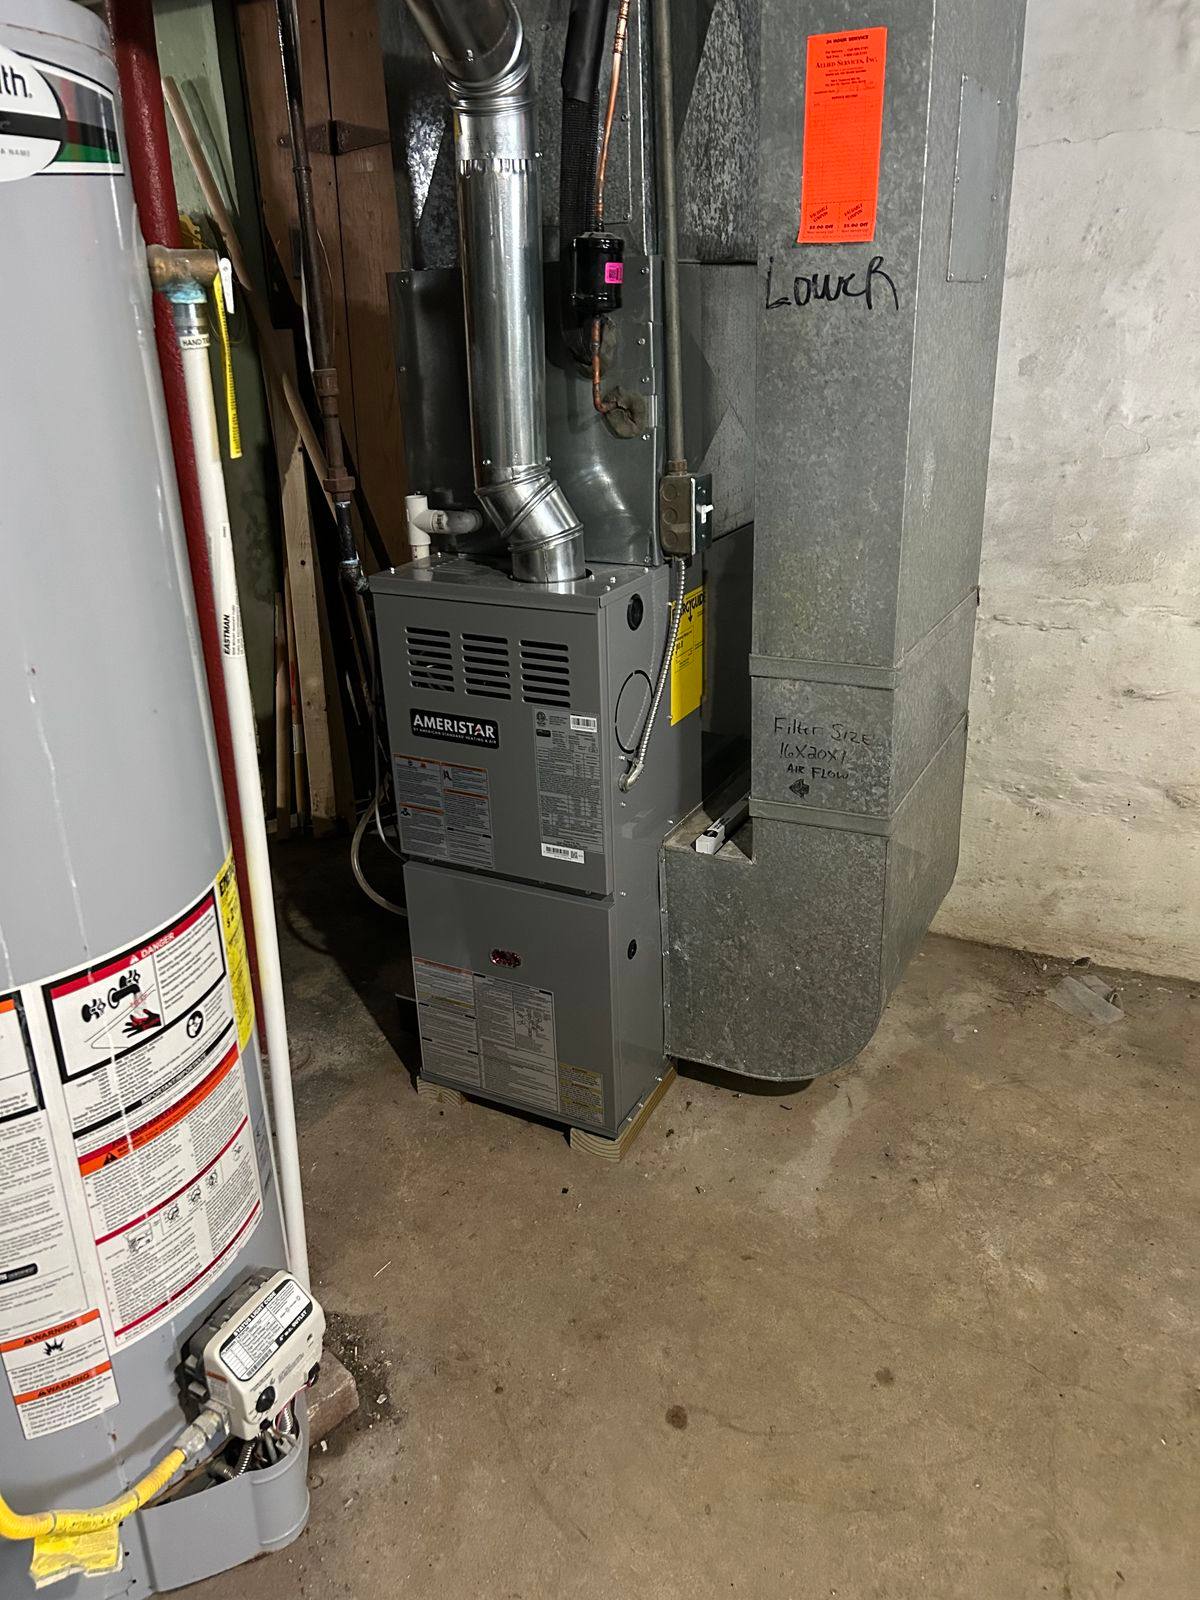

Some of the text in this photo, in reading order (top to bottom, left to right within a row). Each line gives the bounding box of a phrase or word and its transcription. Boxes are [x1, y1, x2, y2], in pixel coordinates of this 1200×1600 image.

[413, 714, 496, 739] AMERISTAR
[774, 717, 824, 736] Filter
[786, 763, 849, 779] AIR FLOW
[140, 931, 175, 959] DANGER
[32, 1320, 78, 1342] WARNING
[45, 1372, 90, 1394] WARNING
